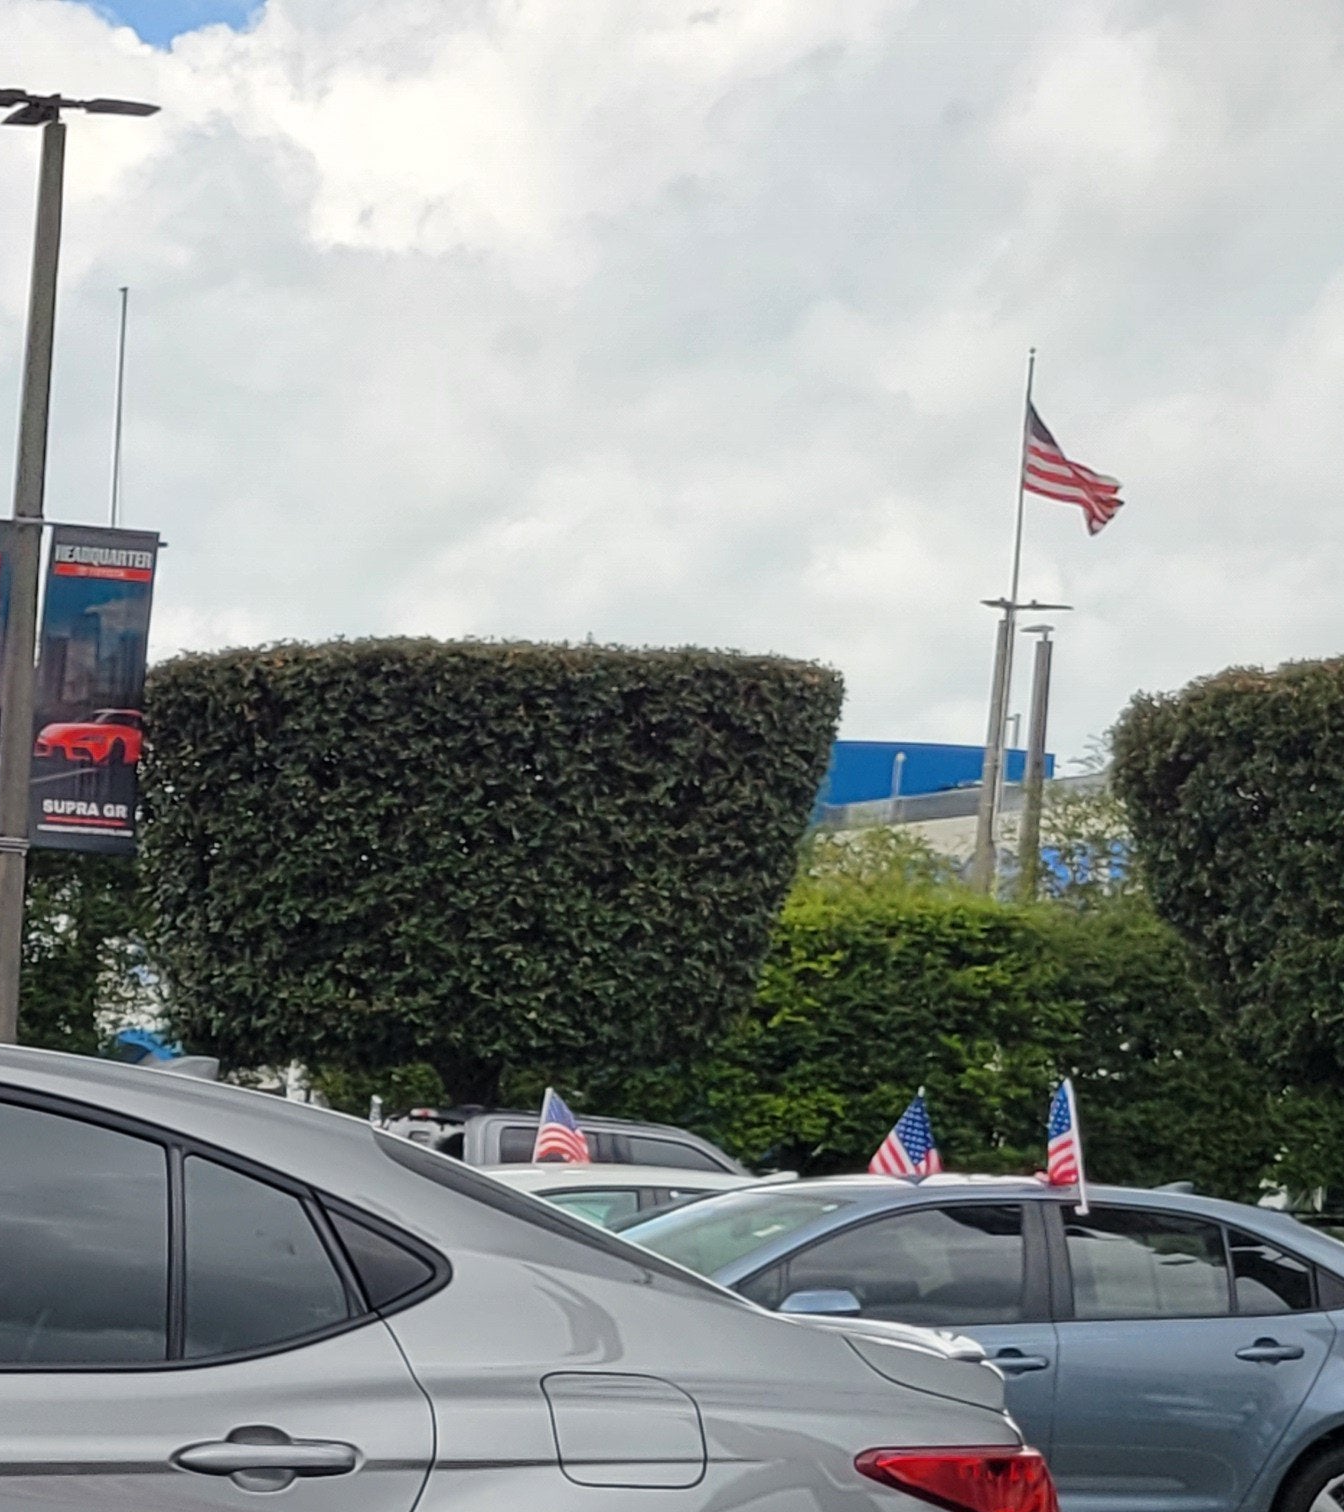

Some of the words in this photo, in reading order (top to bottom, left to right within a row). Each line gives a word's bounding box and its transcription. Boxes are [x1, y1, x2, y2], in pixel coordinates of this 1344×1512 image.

[54, 544, 152, 570] HEADQUARTER
[43, 798, 100, 817] SUPRA
[103, 803, 129, 819] GR
